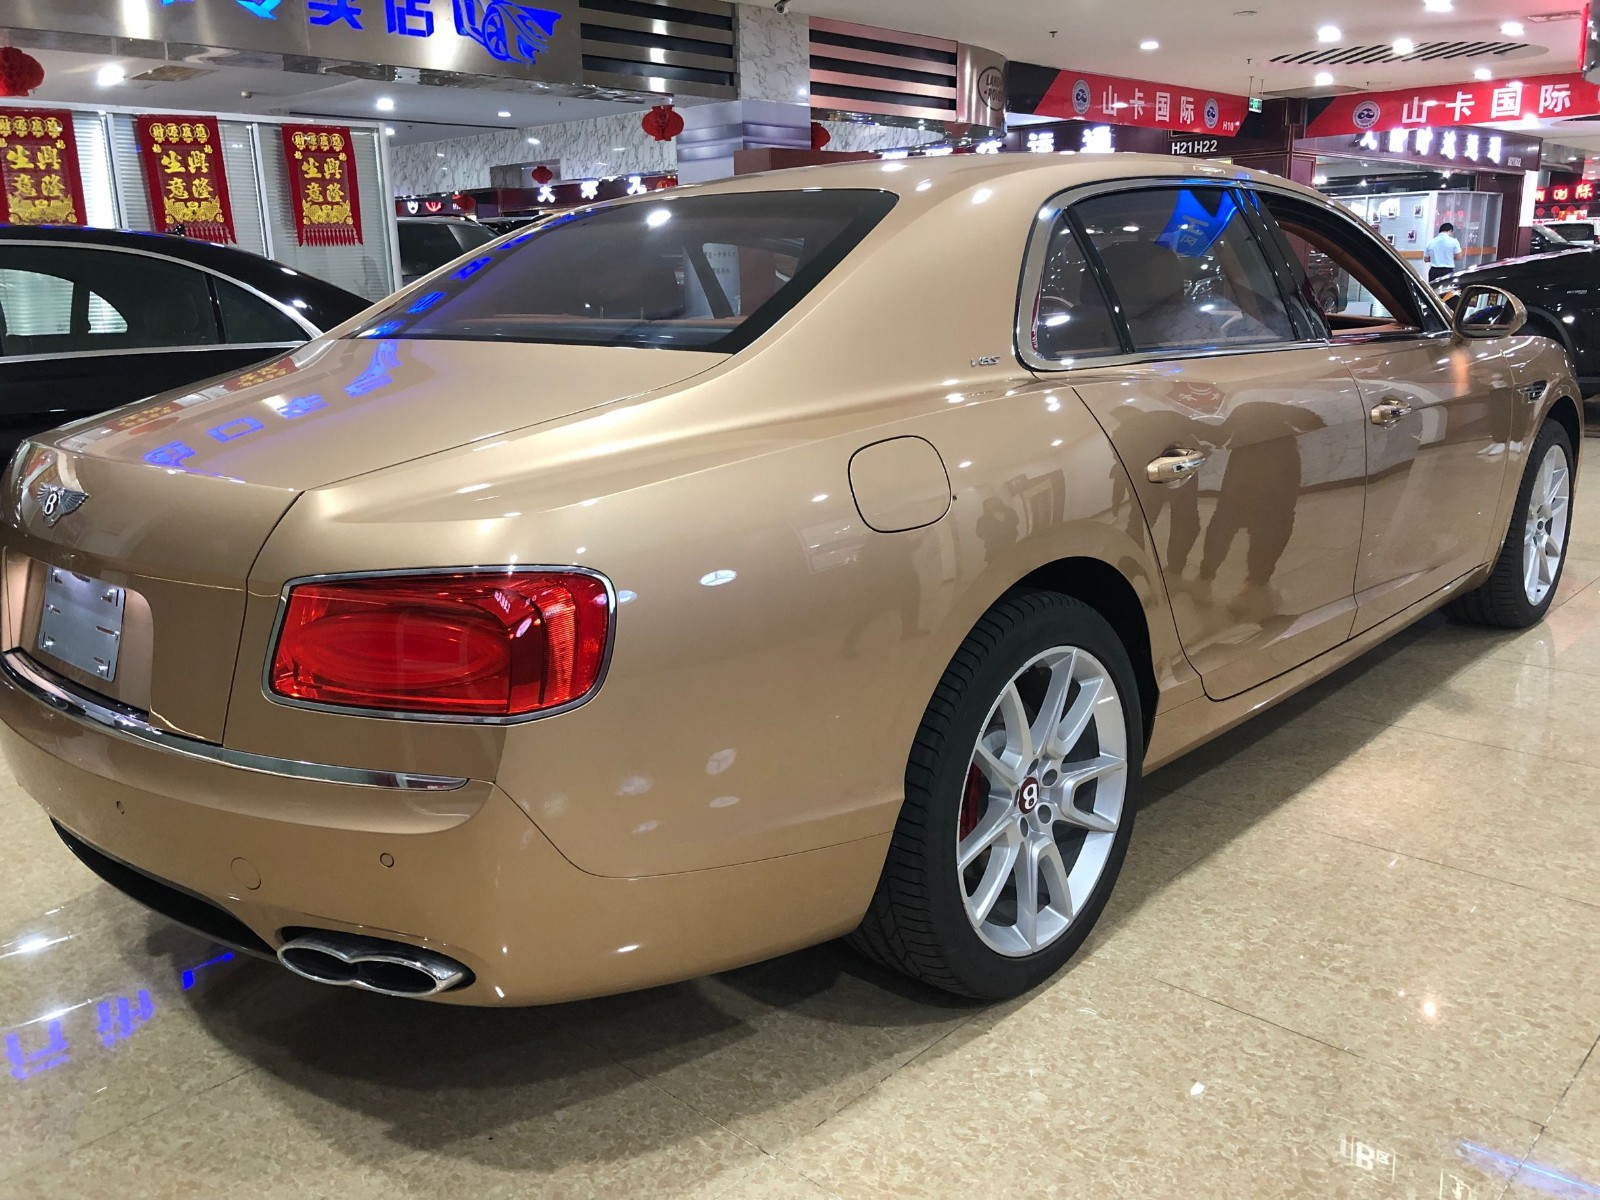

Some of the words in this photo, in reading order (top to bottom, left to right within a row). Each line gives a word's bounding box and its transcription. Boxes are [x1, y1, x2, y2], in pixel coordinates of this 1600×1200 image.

[1102, 85, 1194, 125] 山卡国际
[1401, 83, 1571, 124] 山卡国际
